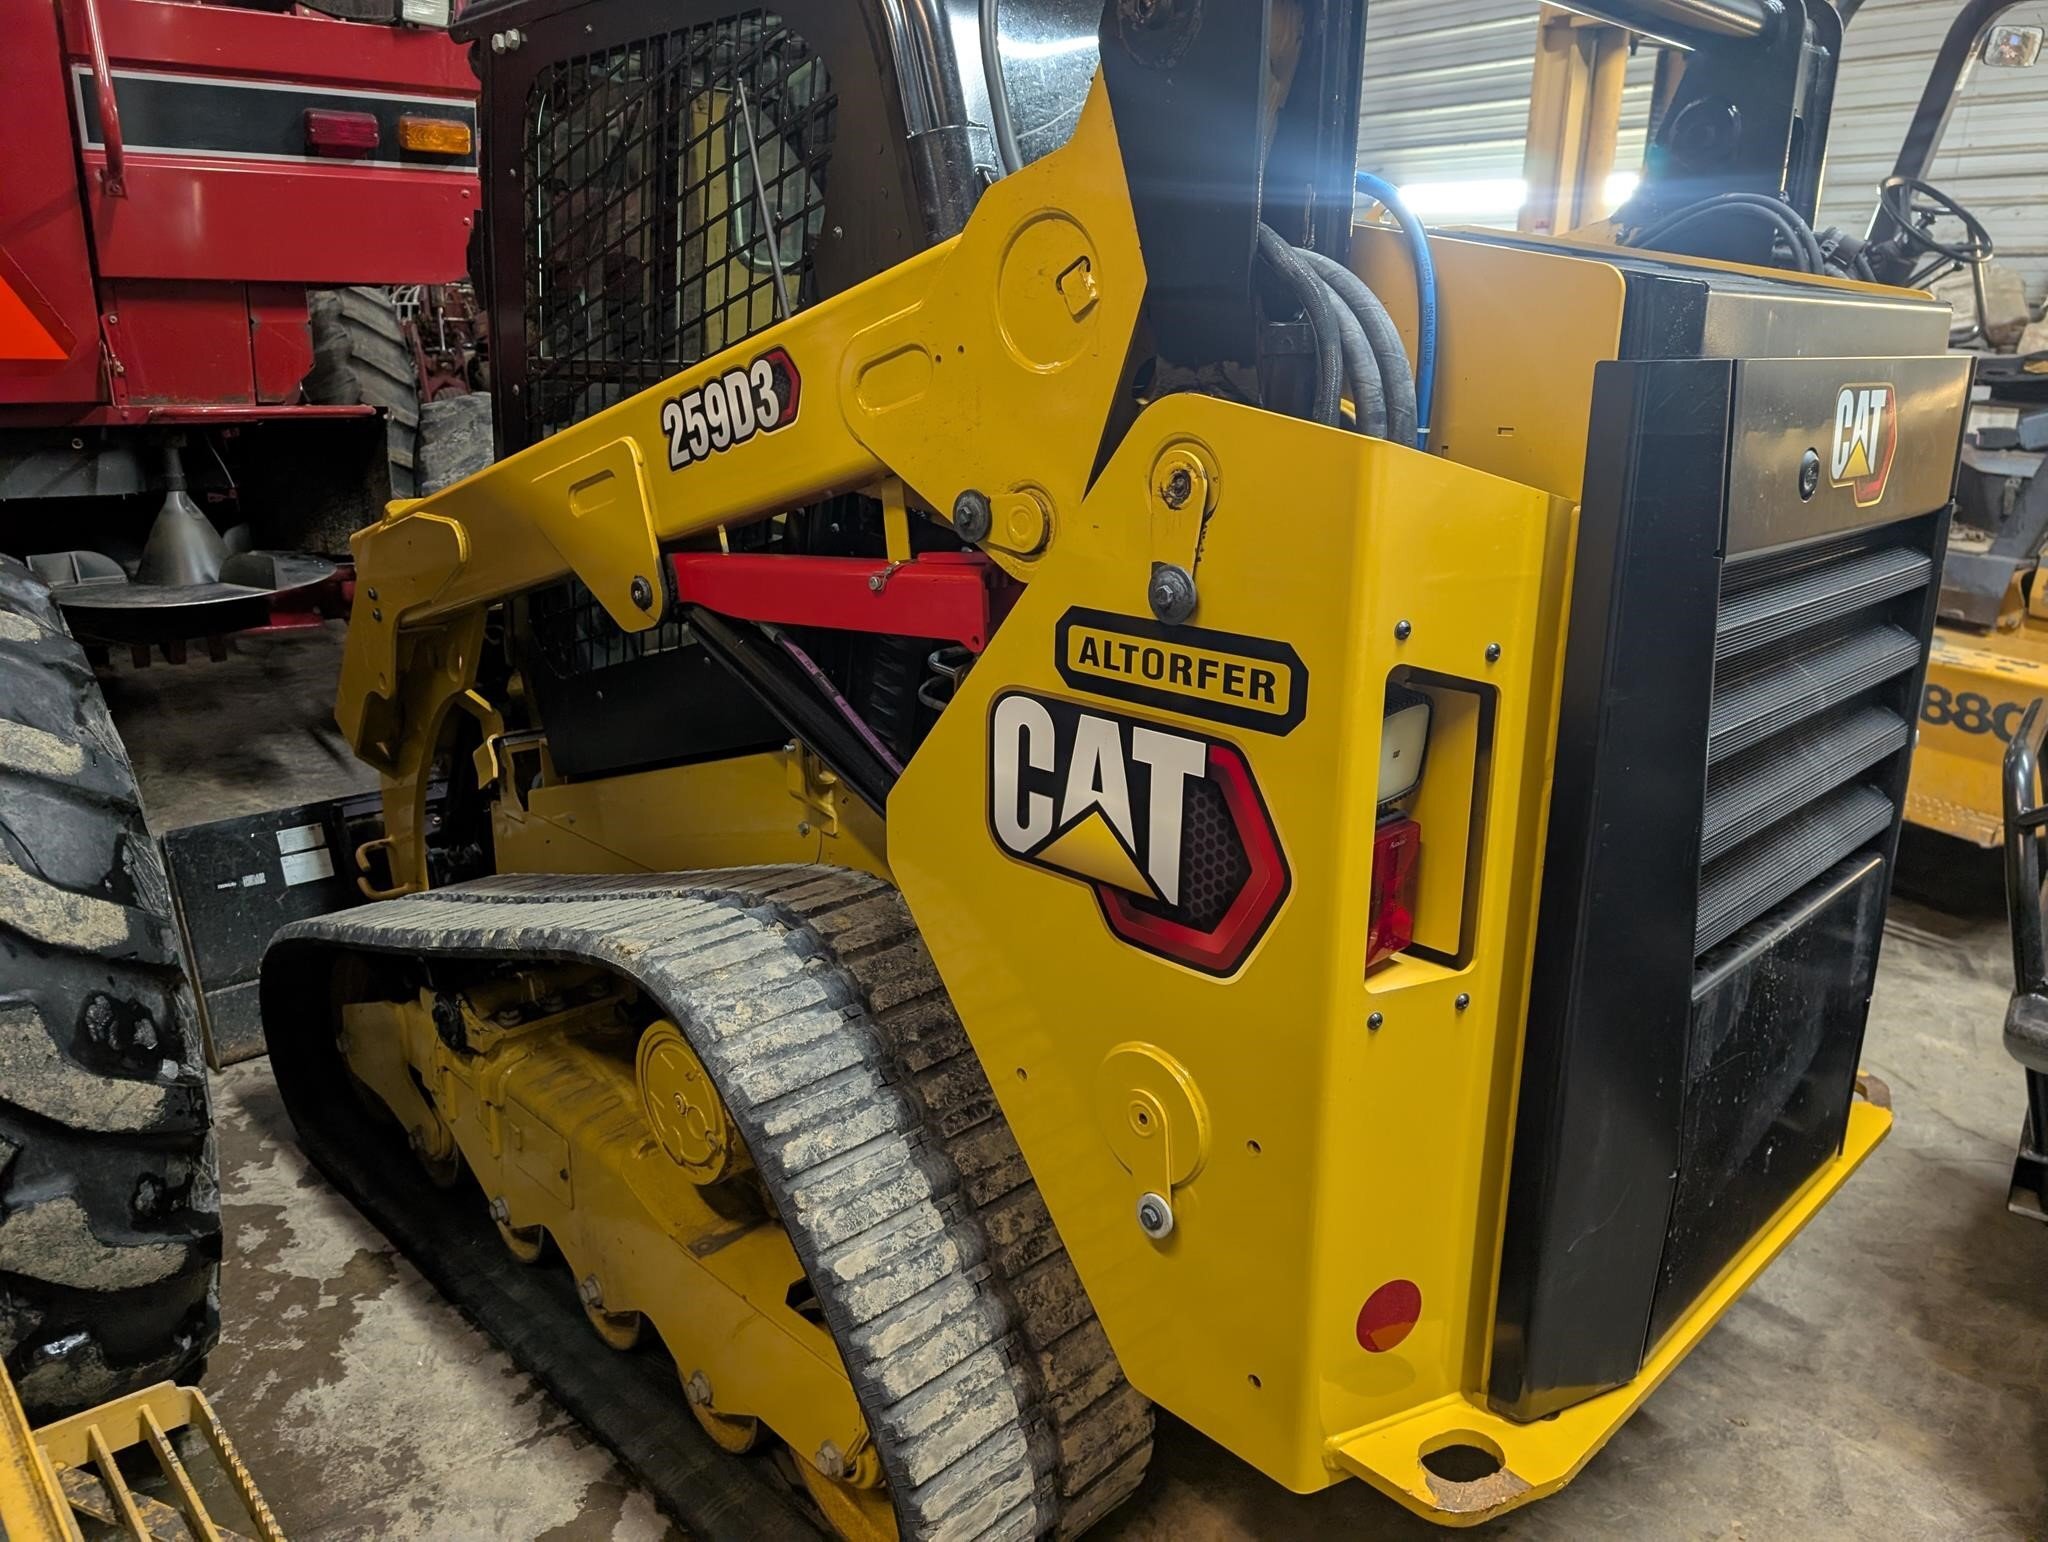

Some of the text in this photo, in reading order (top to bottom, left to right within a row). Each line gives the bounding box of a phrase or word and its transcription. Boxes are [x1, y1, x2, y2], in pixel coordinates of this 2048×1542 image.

[663, 359, 780, 467] 259D3
[1831, 388, 1887, 480] CAT
[1078, 636, 1276, 704] ALTORFER
[994, 695, 1206, 907] CAT
